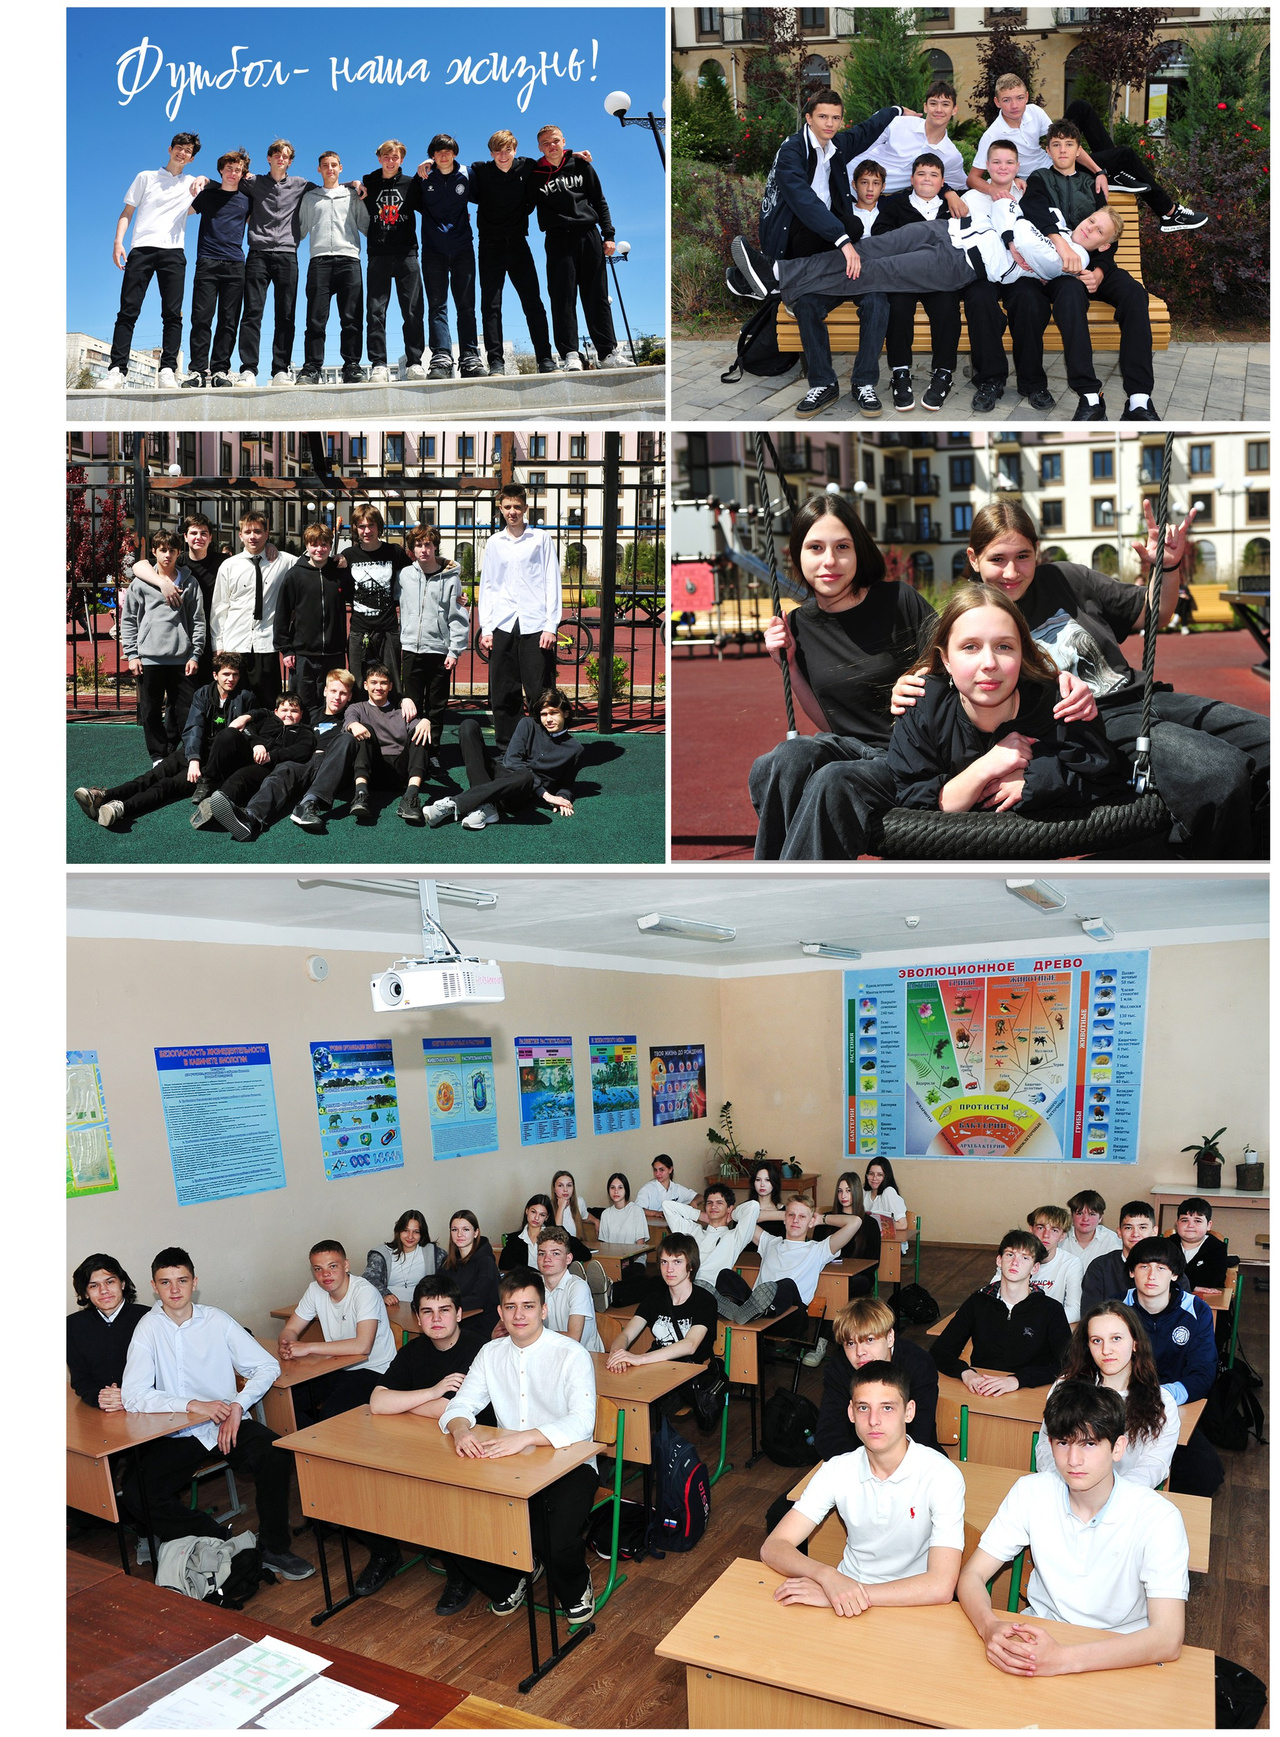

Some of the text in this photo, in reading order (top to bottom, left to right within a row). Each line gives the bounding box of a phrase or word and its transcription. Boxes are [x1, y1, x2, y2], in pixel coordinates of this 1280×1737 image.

[539, 174, 584, 196] VENUM
[898, 958, 1083, 978] ЭВОЛЮЦИОННОЕ ДРЕВО
[1009, 975, 1056, 983] ЖИВОТНЫЕ
[1079, 1008, 1087, 1048] ЖИВОТНЫЕ
[158, 1047, 207, 1058] БЕЗОПАСНОСТЬ
[959, 1103, 1009, 1111] ПРОТИСТЫ
